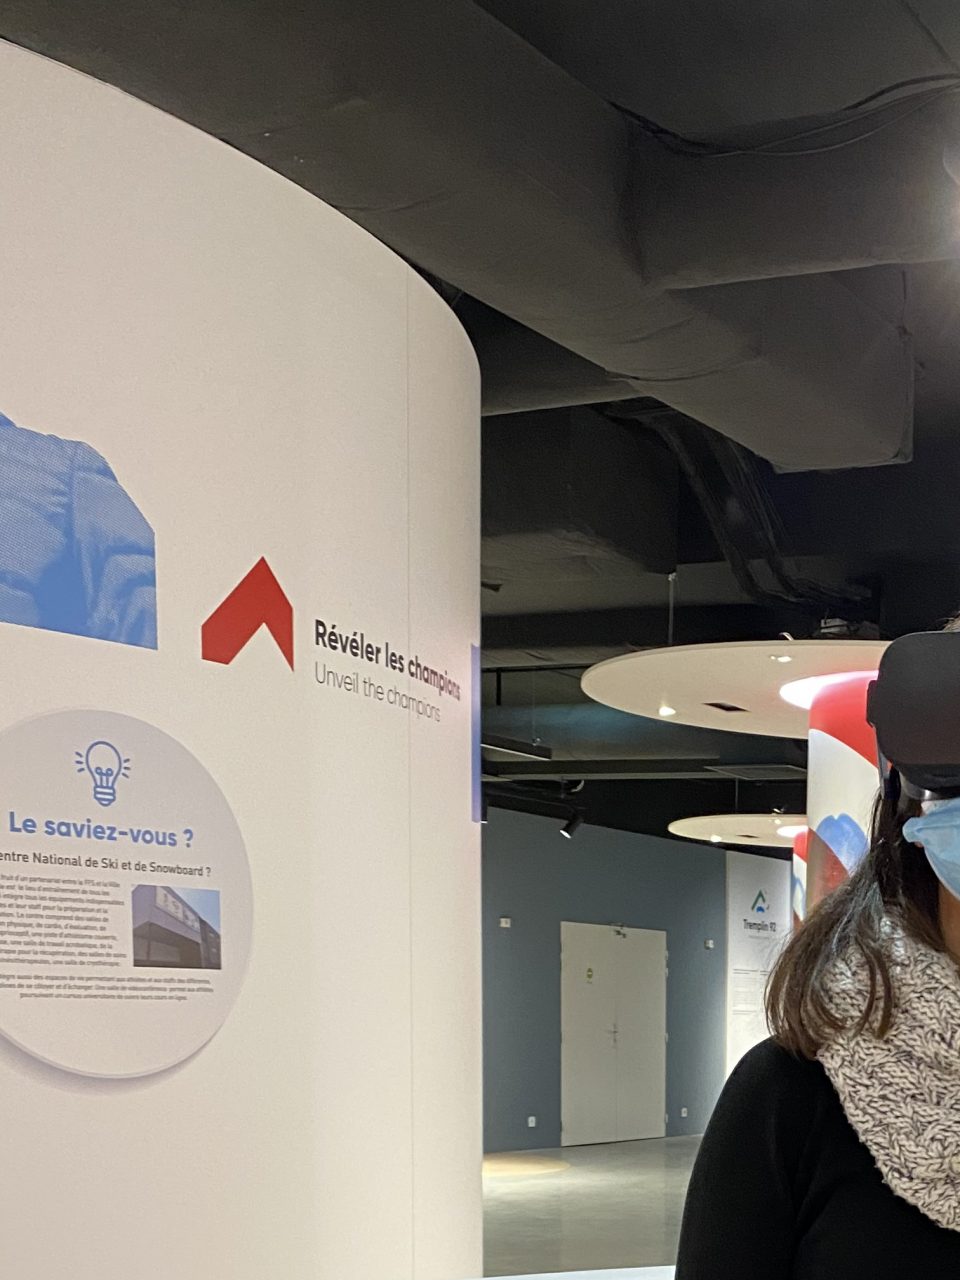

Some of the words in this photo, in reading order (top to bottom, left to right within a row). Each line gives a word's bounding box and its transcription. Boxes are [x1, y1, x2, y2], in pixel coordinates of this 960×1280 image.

[315, 619, 381, 664] Révéler
[385, 642, 404, 673] les
[408, 655, 461, 701] champions
[315, 661, 359, 694] Unveil
[363, 677, 384, 701] the
[387, 685, 441, 722] champions
[9, 811, 37, 834] Le
[44, 818, 178, 847] saviez-vous
[183, 829, 194, 848] ?
[32, 852, 82, 868] National
[85, 855, 99, 868] de
[101, 857, 118, 870] Ski
[121, 860, 132, 871] et
[134, 860, 147, 872] de
[150, 862, 204, 877] Snowboard
